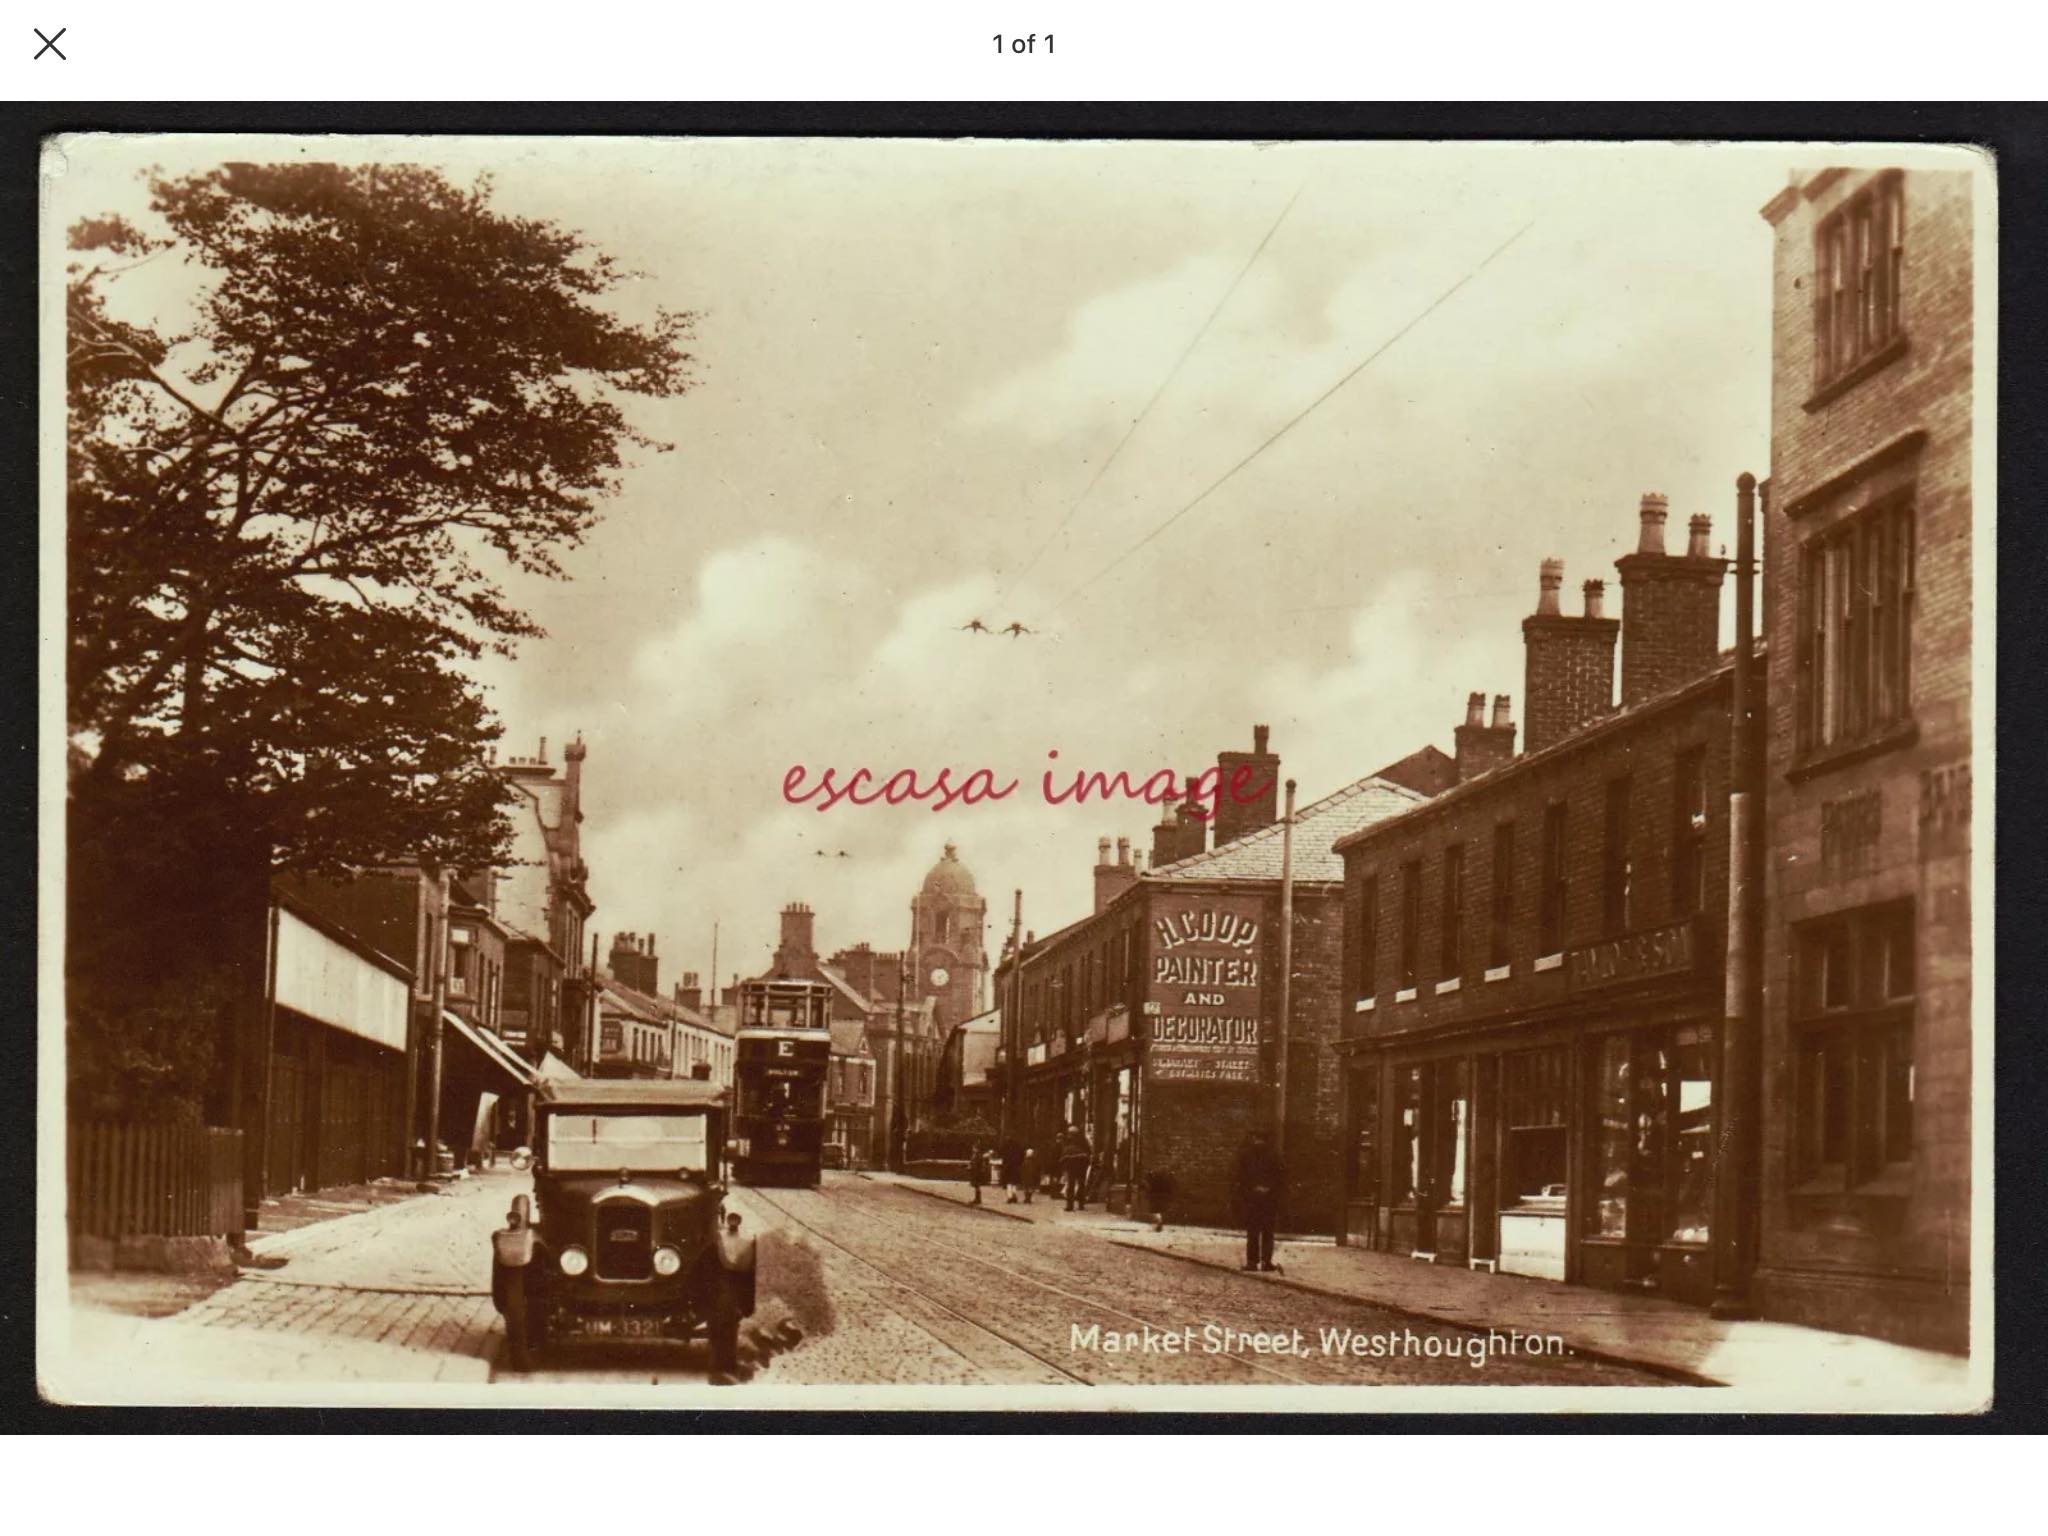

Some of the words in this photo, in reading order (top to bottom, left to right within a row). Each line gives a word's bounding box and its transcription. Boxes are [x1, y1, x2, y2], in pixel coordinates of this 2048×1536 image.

[1154, 957, 1258, 987] PAINTER
[1184, 992, 1225, 1006] AND
[1151, 1015, 1259, 1045] DECORATOR
[778, 1041, 794, 1057] E
